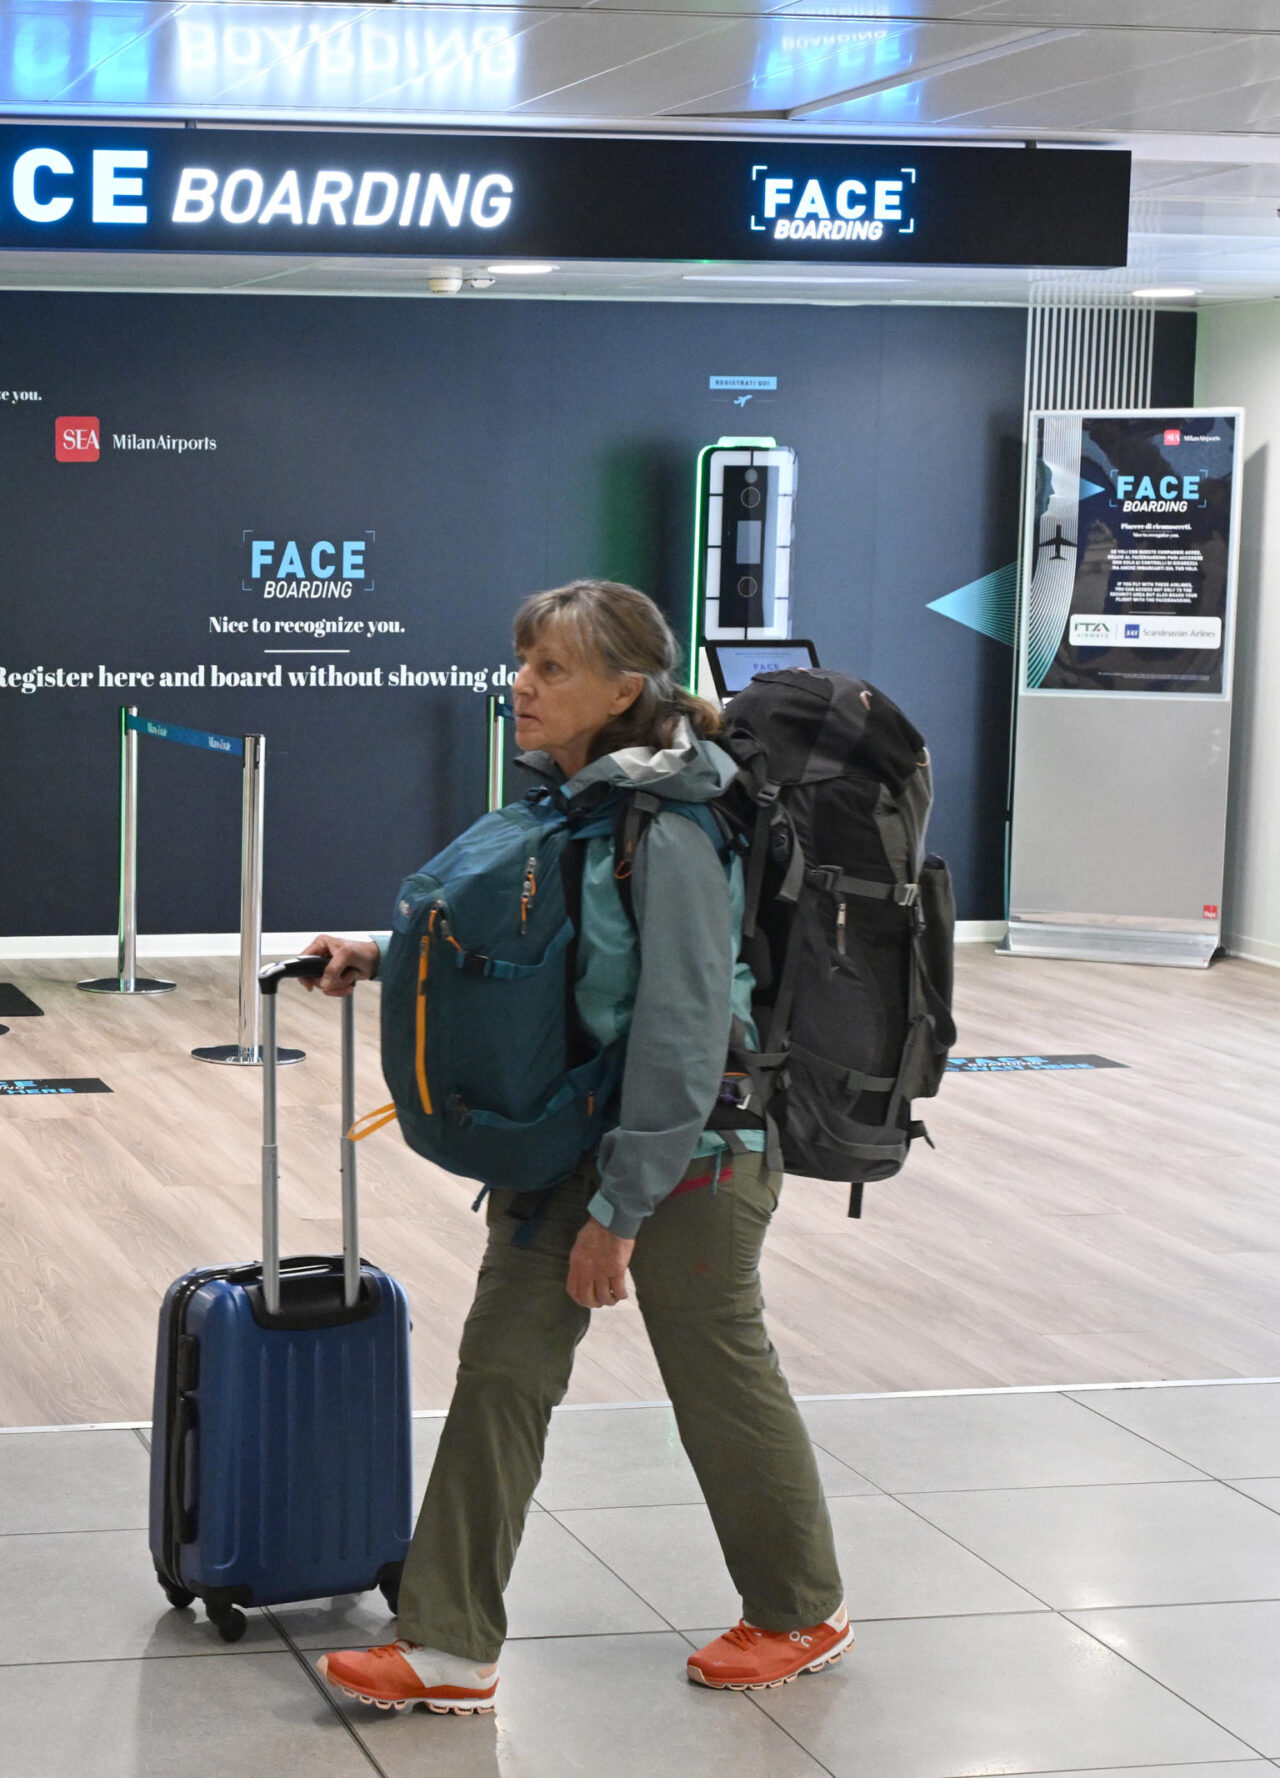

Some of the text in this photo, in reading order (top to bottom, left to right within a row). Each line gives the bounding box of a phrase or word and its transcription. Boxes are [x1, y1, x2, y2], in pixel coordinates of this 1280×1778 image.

[172, 168, 514, 228] BOARDING
[764, 178, 904, 221] FACE
[774, 219, 884, 241] BOARDING
[11, 390, 43, 404] you.
[63, 429, 217, 453] SEA MilanAirports
[1117, 475, 1200, 500] FACE
[1122, 500, 1189, 513] BOARDING
[251, 540, 366, 580] FACE
[263, 580, 354, 599] BOARDING
[209, 616, 406, 638] Nice to recognize you.
[1074, 623, 1110, 632] ITA
[1143, 629, 1188, 638] Scandinavian
[1191, 630, 1216, 638] Airlines
[98, 665, 155, 688] here
[159, 665, 205, 688] and
[210, 664, 282, 688] board
[287, 664, 384, 687] without
[387, 664, 489, 693] showing
